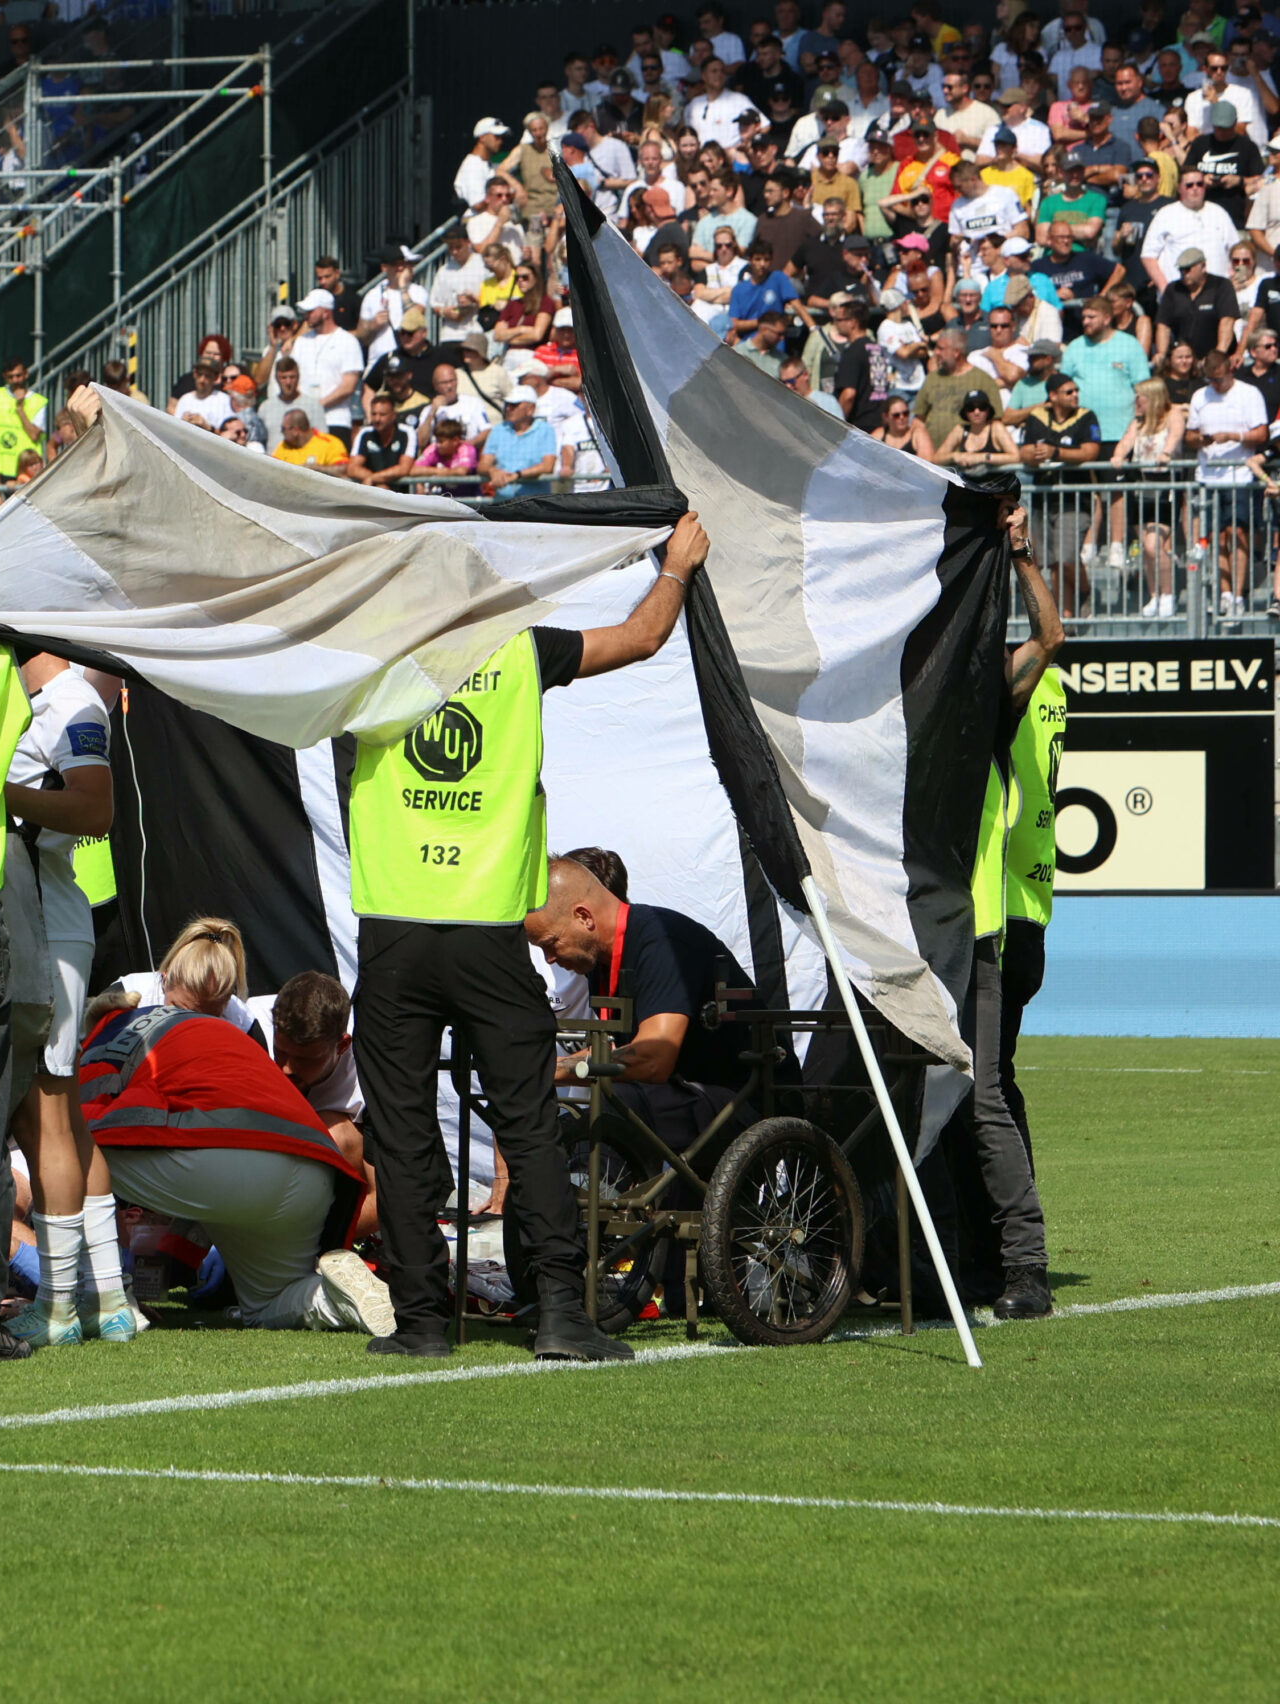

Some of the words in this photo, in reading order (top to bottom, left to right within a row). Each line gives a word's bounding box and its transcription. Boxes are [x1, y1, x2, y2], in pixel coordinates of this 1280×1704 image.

[1190, 658, 1268, 691] ELV.
[402, 788, 483, 812] SERVICE
[420, 844, 461, 866] 132
